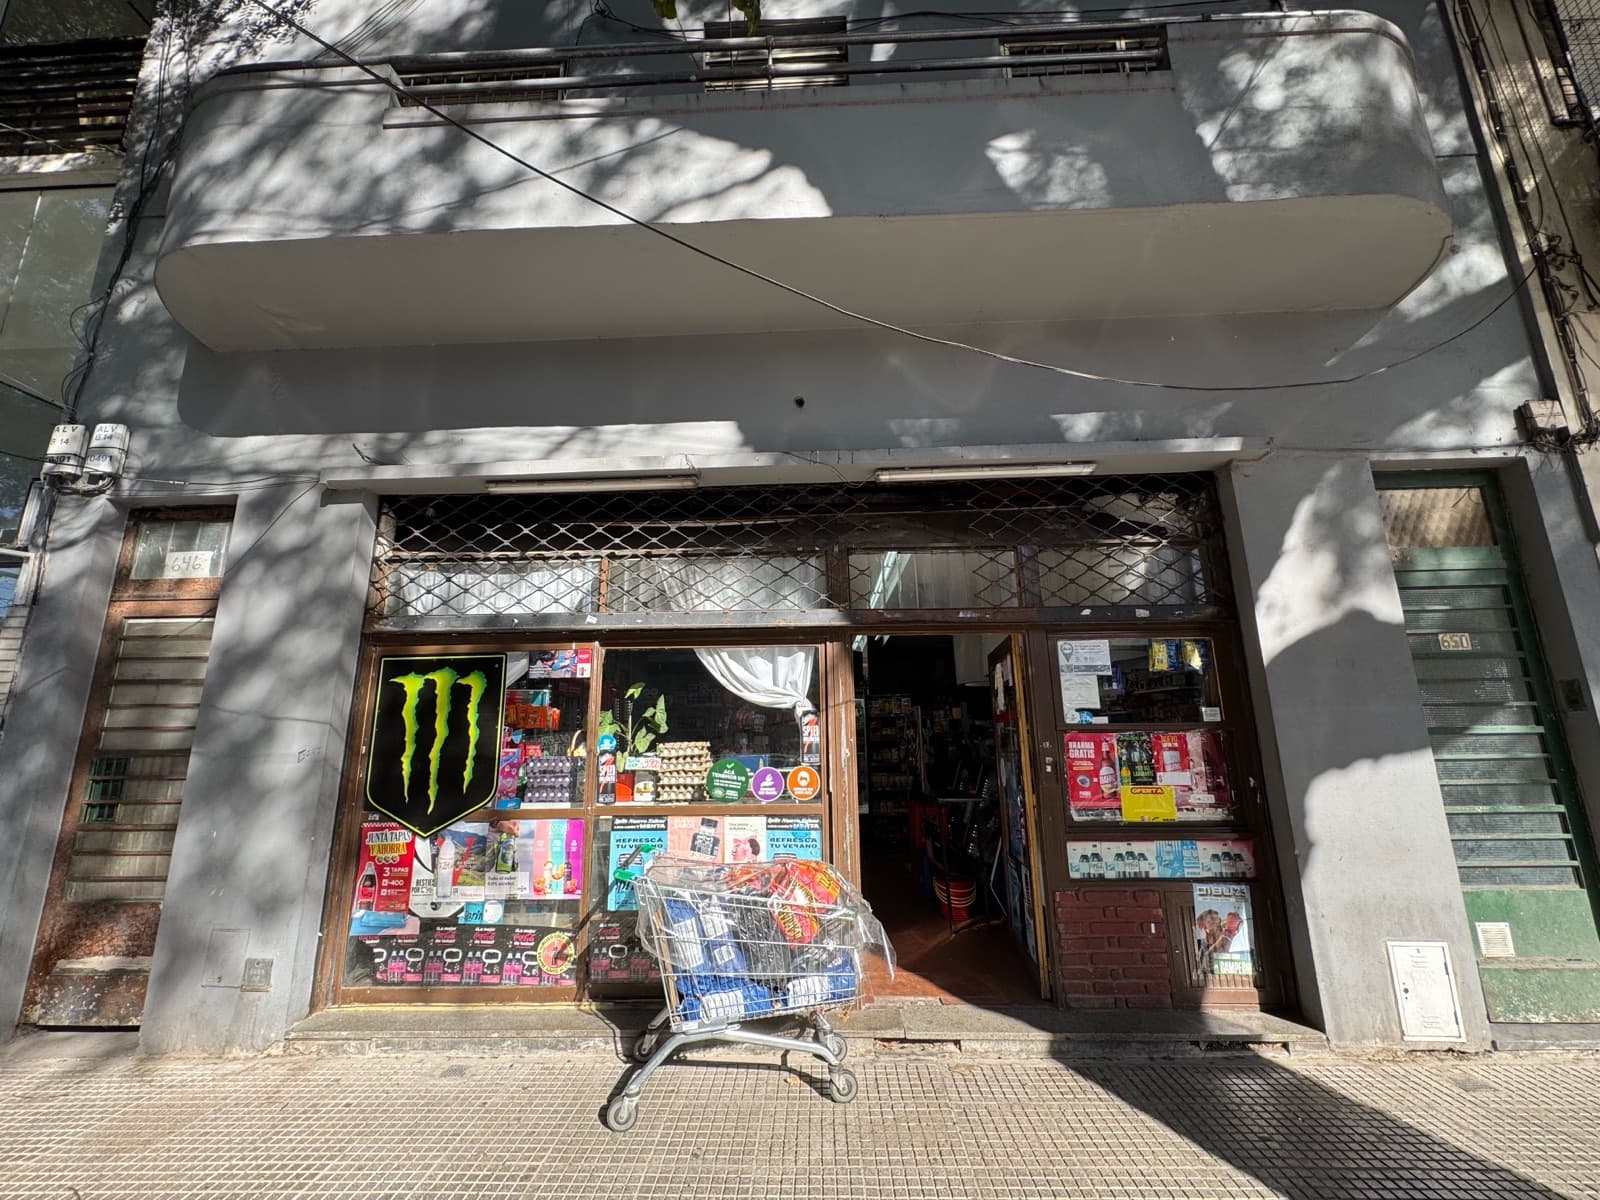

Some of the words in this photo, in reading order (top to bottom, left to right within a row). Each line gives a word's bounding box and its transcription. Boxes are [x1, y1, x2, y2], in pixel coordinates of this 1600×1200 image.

[1069, 750, 1095, 758] GRATIS
[367, 829, 389, 843] JUNTÁ
[390, 829, 411, 841] TAPAS
[382, 867, 391, 877] 3
